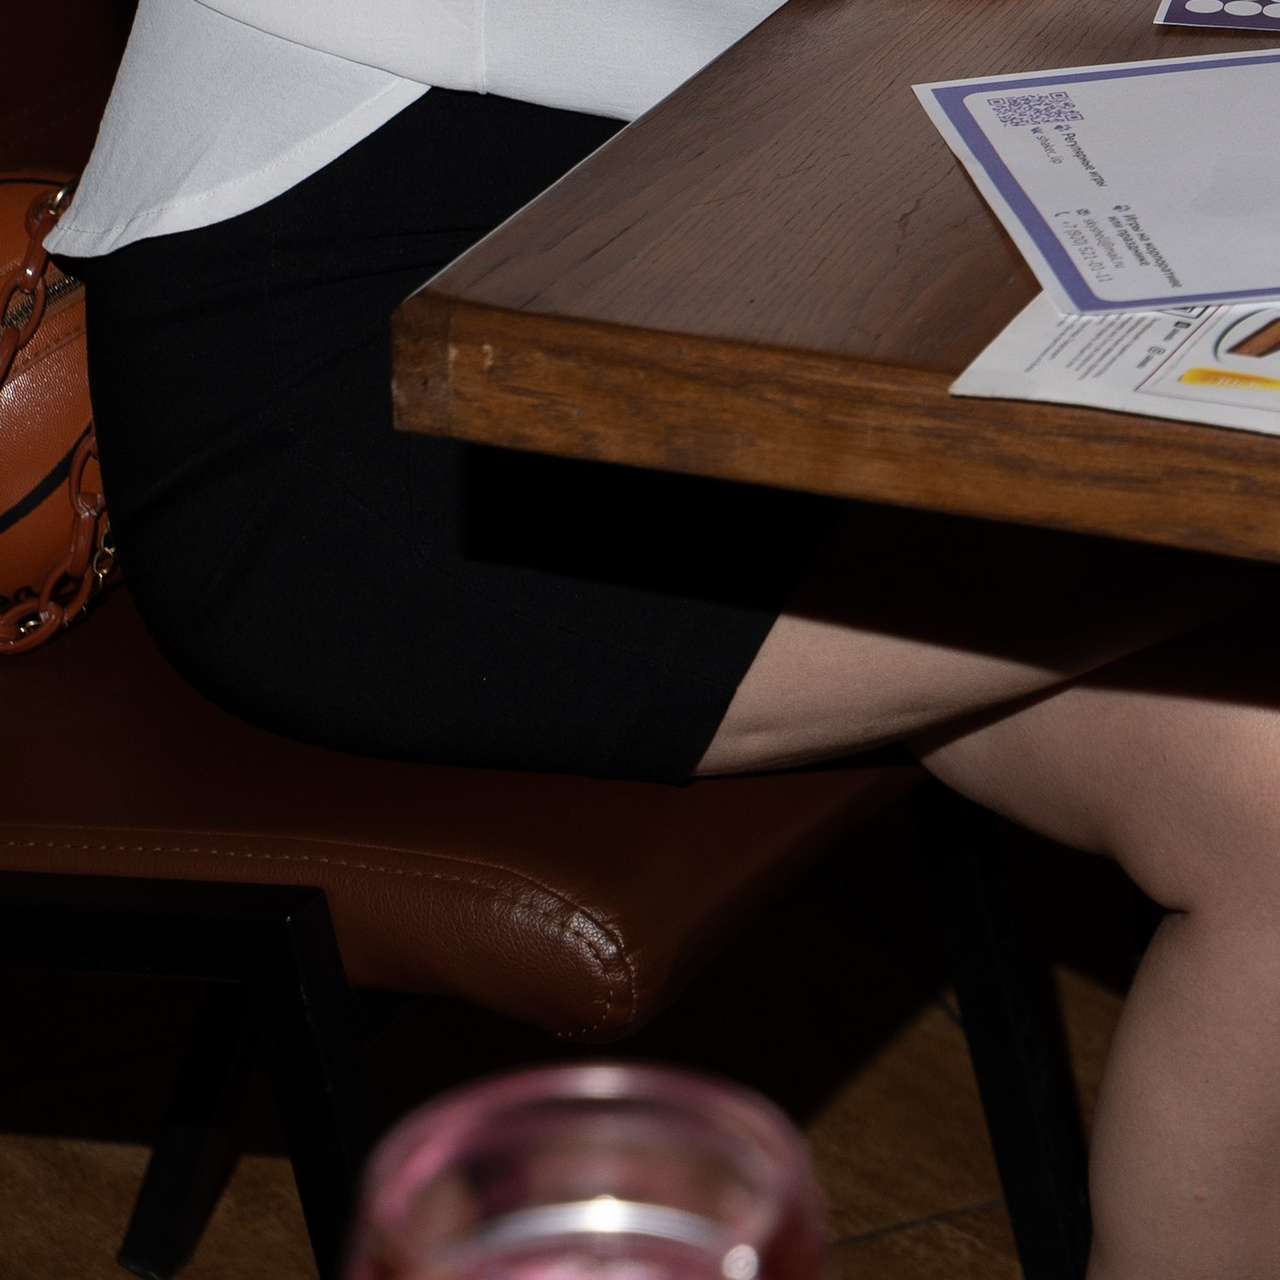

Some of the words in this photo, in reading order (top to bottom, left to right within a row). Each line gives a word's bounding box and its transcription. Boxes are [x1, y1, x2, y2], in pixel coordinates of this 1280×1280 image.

[1062, 133, 1095, 170] Регулярные
[1089, 171, 1107, 186] игры
[1065, 230, 1087, 246] (920)
[1078, 246, 1112, 282] 521-01-11
[1123, 214, 1142, 232] Игры
[1138, 243, 1181, 287] корпоративе
